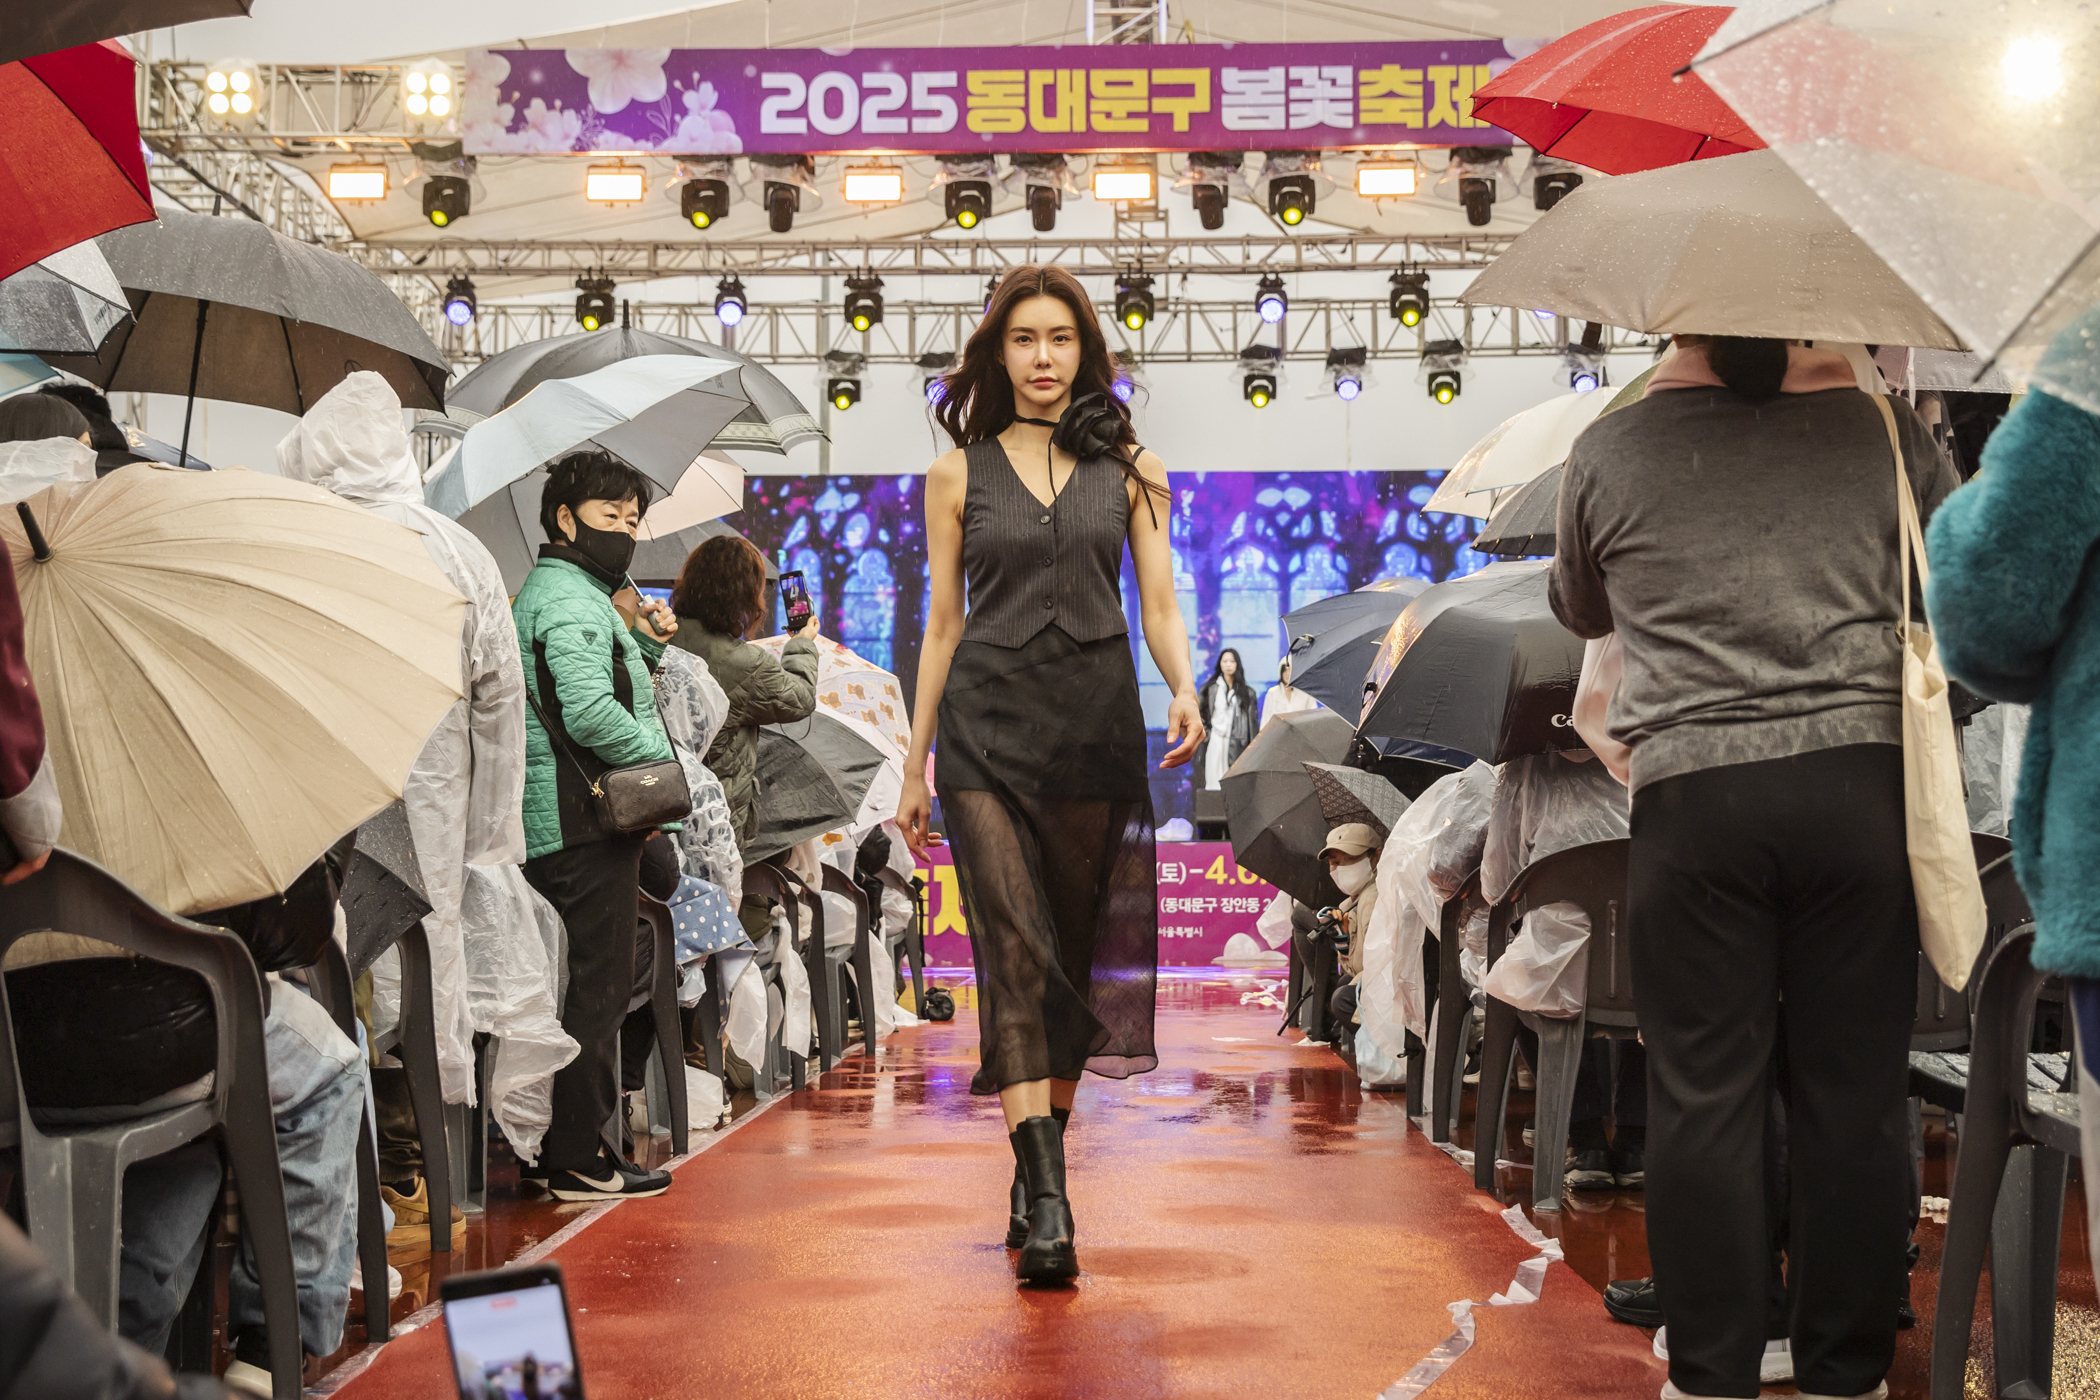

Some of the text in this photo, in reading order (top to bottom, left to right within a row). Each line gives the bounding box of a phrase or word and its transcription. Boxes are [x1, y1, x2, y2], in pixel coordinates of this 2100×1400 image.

[760, 71, 959, 135] 2025
[966, 67, 1211, 133] 동대문구
[1220, 897, 1260, 913] 장안동
